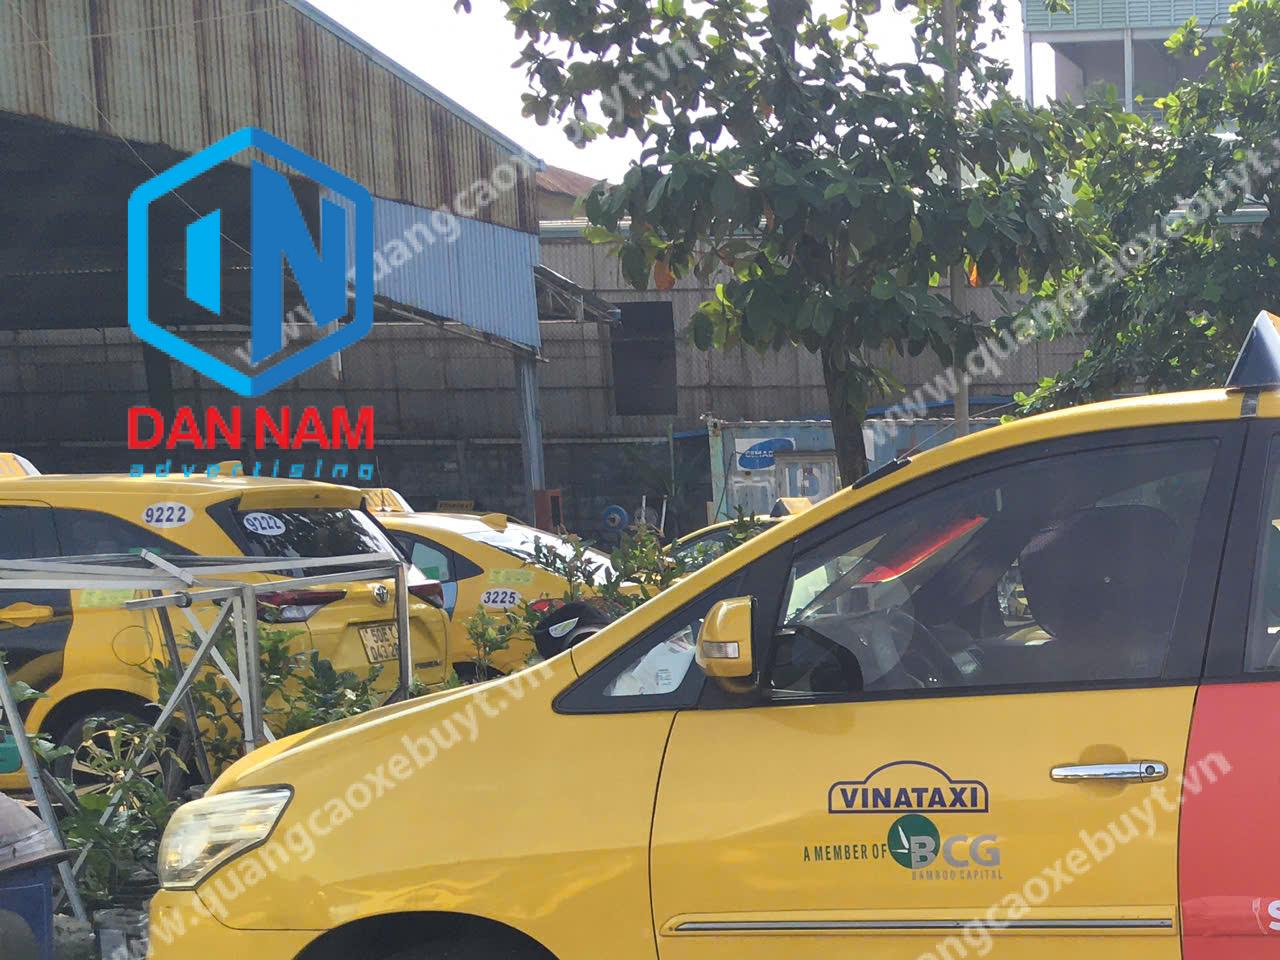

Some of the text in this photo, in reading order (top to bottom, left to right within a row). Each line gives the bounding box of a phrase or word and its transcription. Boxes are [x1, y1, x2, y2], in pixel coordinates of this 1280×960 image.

[145, 506, 187, 523] 9222
[245, 515, 282, 532] 9222
[483, 590, 516, 604] 3225
[840, 786, 979, 808] VINATAXI
[803, 843, 888, 862] A MEMBER OF
[910, 834, 1001, 870] BCG
[911, 870, 1002, 880] BAMBOO CAPITAL
